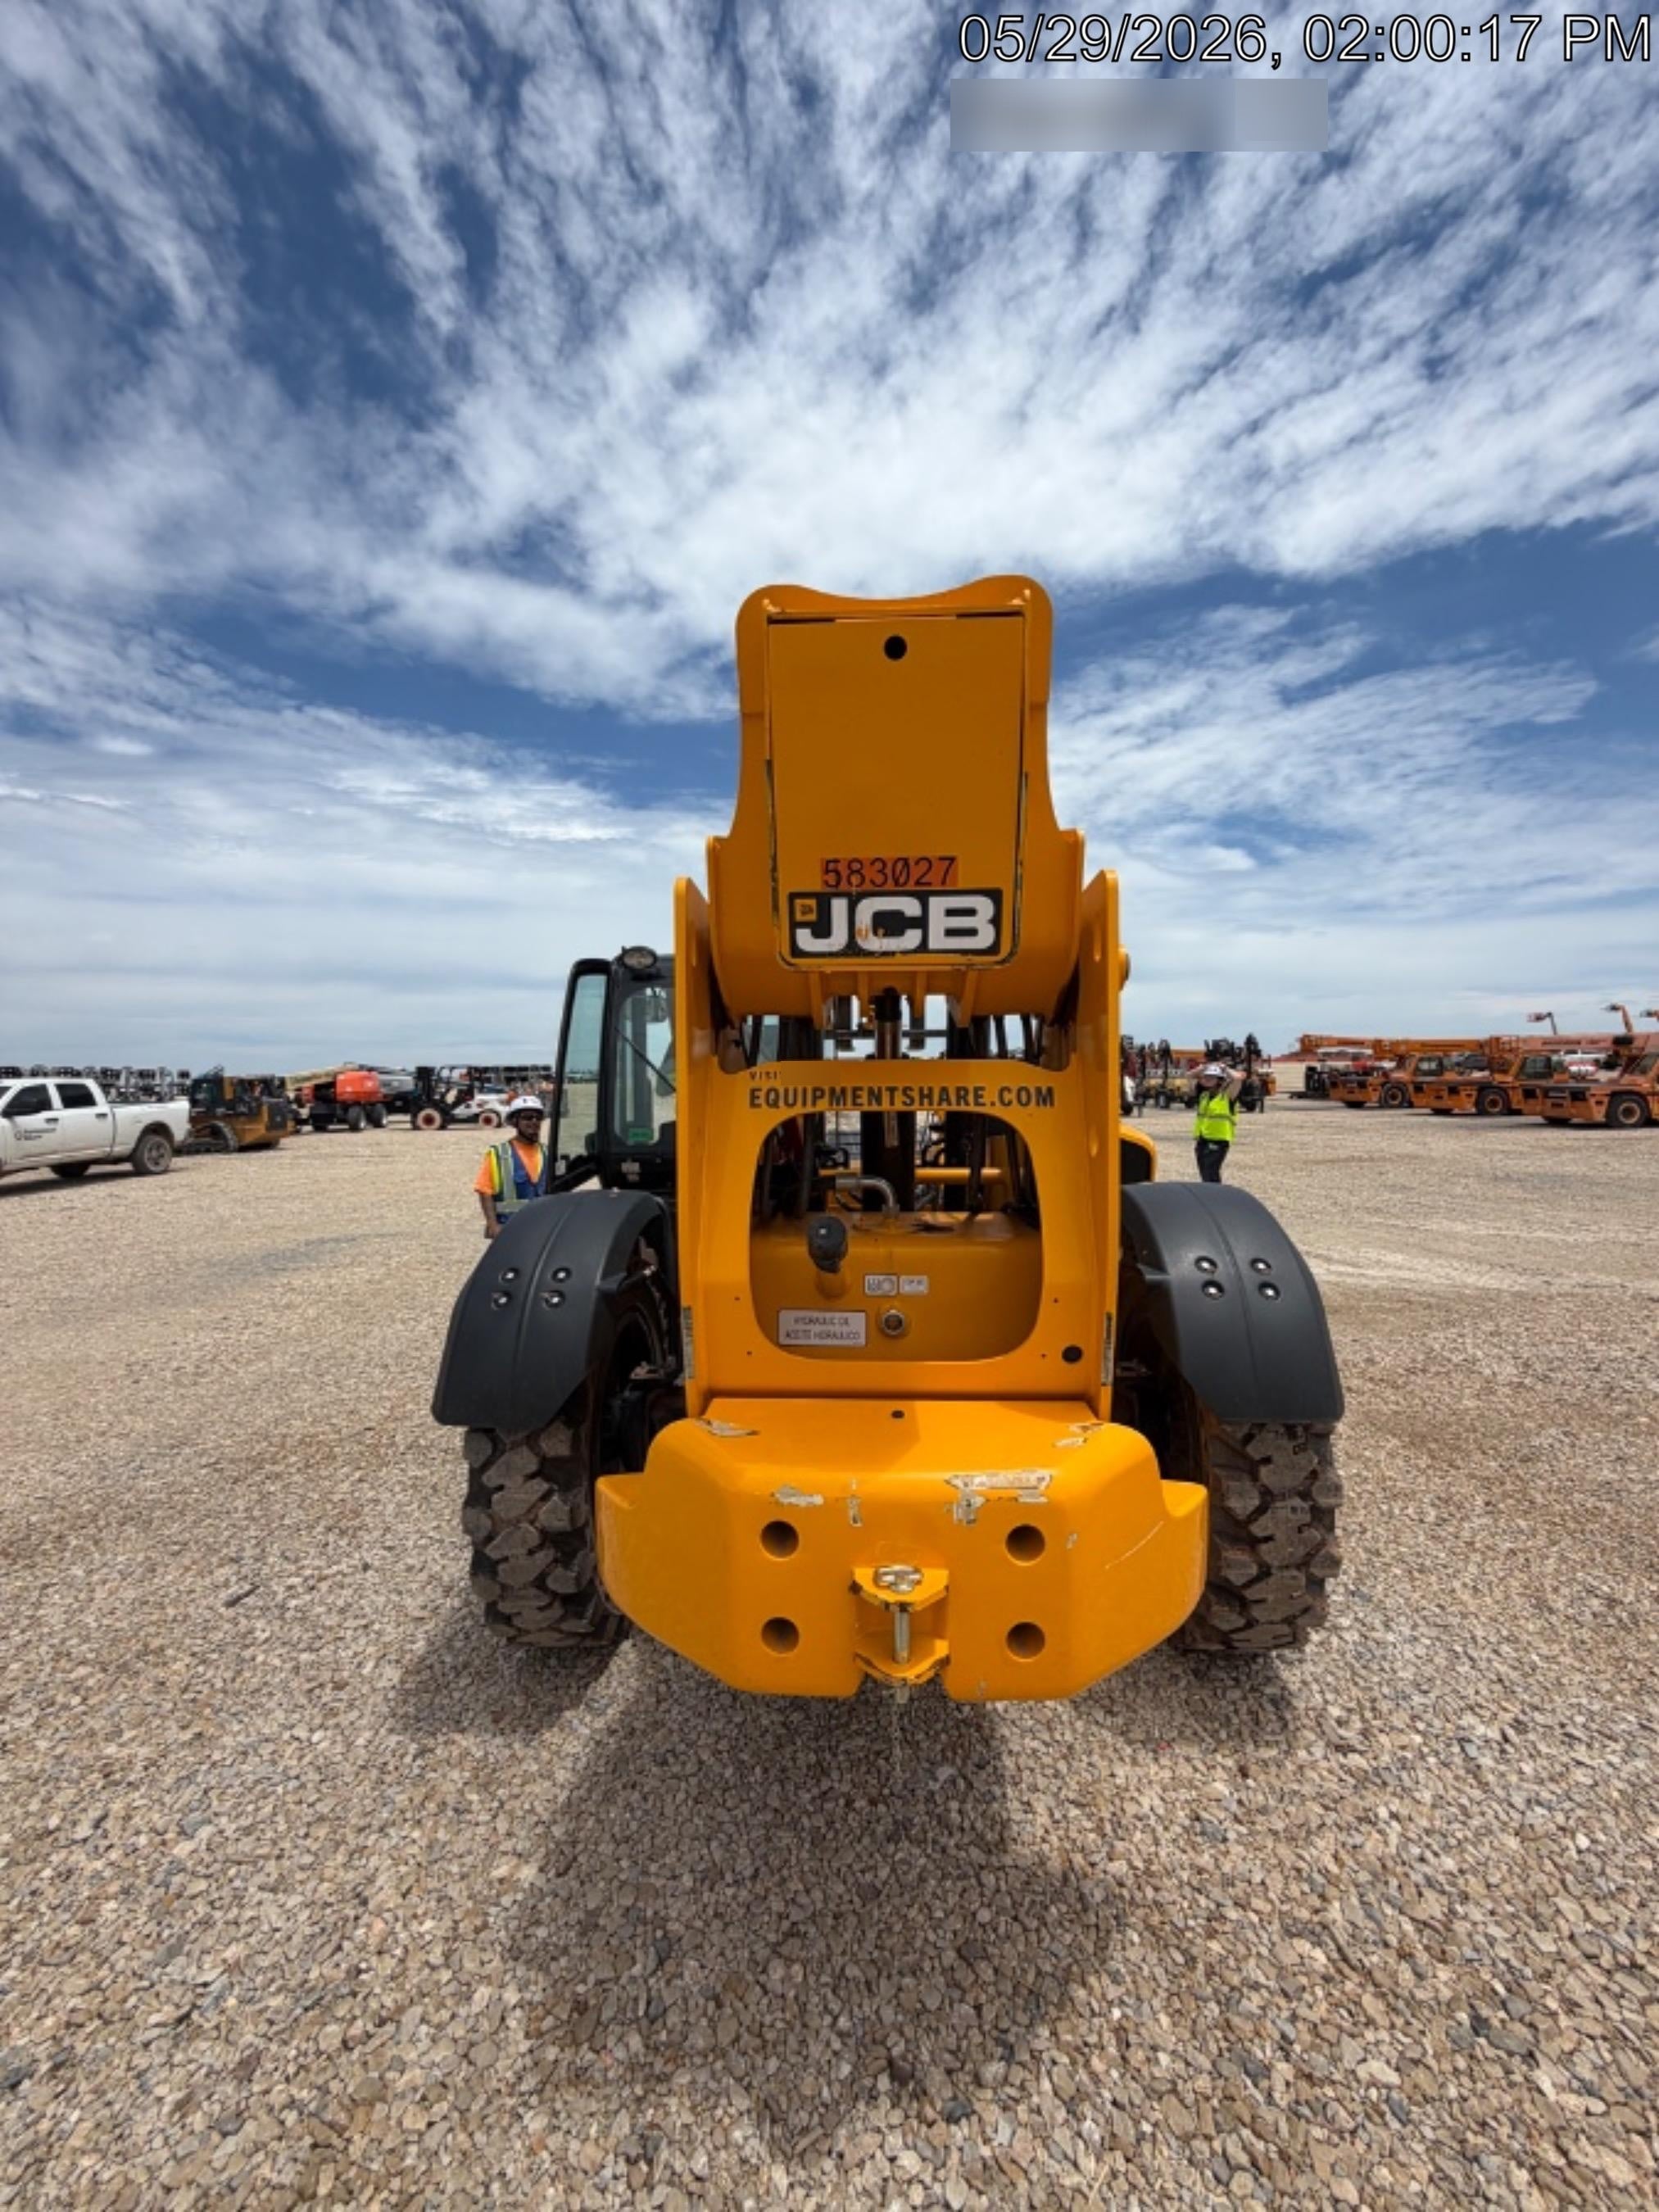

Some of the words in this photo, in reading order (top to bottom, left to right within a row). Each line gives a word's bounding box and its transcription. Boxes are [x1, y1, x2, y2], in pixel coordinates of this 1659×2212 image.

[823, 857, 956, 887] 583027
[795, 895, 995, 953] JCB
[749, 1071, 782, 1081] VISI
[749, 1086, 1055, 1108] EQUIPMENTSHARE.COM
